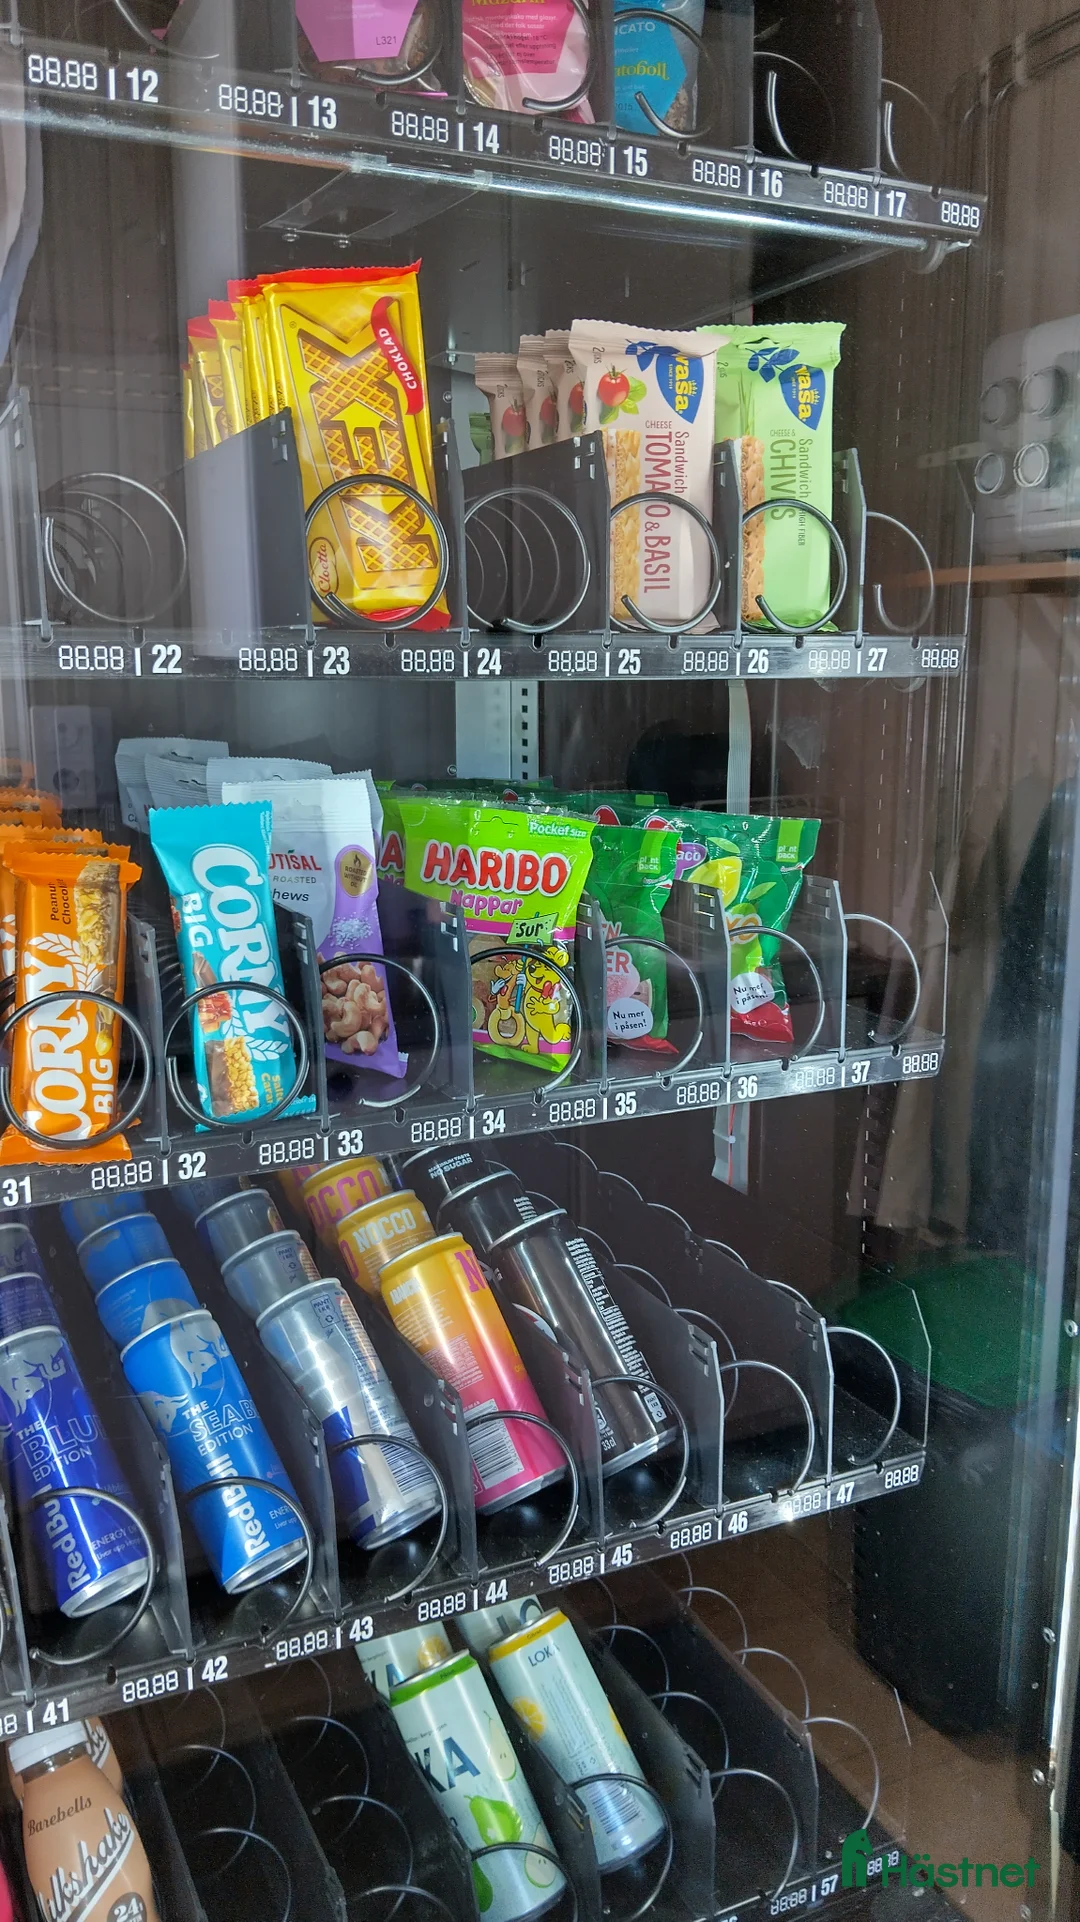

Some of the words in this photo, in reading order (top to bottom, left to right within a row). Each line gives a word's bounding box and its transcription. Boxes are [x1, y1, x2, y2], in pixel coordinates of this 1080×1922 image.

[376, 36, 397, 45] L321
[28, 54, 98, 91] 88.88
[126, 68, 159, 103] 12
[218, 83, 282, 118] 88.88
[308, 96, 338, 129] 13
[392, 110, 449, 143] 88.88
[473, 122, 501, 154] 14
[549, 135, 602, 166] 88.88
[623, 146, 648, 176] 15
[692, 158, 741, 188] 88.88
[760, 169, 783, 198] 16
[824, 181, 868, 209] 88.88
[885, 191, 907, 218] 17
[941, 201, 980, 228] 88.88
[379, 327, 418, 391] CHOKLAD
[645, 420, 672, 429] CHEESE
[769, 429, 790, 437] CHEESE
[645, 431, 673, 518] TOMAO
[675, 431, 689, 494] Sandwich
[799, 438, 814, 500] Sandwich
[645, 521, 660, 533] &
[320, 543, 331, 594] Cloetta
[644, 536, 672, 594] BASIL
[58, 645, 125, 672] 88.88
[151, 644, 183, 674] 22
[239, 647, 298, 673] 88.88
[323, 646, 350, 675] 23
[401, 648, 455, 673] 88.88
[476, 646, 502, 675] 24
[548, 649, 598, 672] 88.88
[618, 648, 641, 675] 25
[683, 650, 729, 672] 88.88
[747, 648, 769, 674] 26
[808, 649, 851, 671] 88.88
[868, 647, 888, 672] 27
[921, 649, 959, 669] 88.88
[529, 822, 569, 835] Pocket
[639, 855, 659, 864] plnt
[778, 844, 797, 852] plnt
[273, 875, 316, 884] ROASTED
[421, 840, 571, 896] HARIBO
[639, 862, 659, 871] pack
[450, 889, 523, 916] Nappar
[181, 892, 214, 948] BIG
[516, 922, 543, 937] Sur
[192, 846, 289, 1038] CORNY
[733, 985, 747, 997] Nu
[613, 1011, 627, 1020] Nu
[628, 1010, 645, 1019] mer
[620, 1018, 647, 1032] påsen!
[852, 1060, 871, 1084] 37
[903, 1052, 938, 1074] 88.88
[90, 1058, 114, 1115] BIG
[676, 1081, 720, 1105] 88.88
[737, 1075, 758, 1099] 36
[550, 1098, 596, 1123] 88.88
[615, 1091, 637, 1116] 35
[411, 1117, 462, 1143] 88.88
[482, 1109, 506, 1135] 34
[259, 1137, 315, 1165] 88.88
[338, 1128, 364, 1155] 33
[91, 1160, 153, 1191] 88.88
[178, 1152, 207, 1180] 32
[430, 1168, 444, 1179] NO
[443, 1157, 473, 1173] SUGAR
[2, 1176, 32, 1207] 31
[352, 1208, 417, 1254] NOCCO
[313, 1298, 330, 1308] PANT
[182, 1400, 209, 1420] THE
[189, 1403, 244, 1442] SEA
[16, 1420, 42, 1440] THE
[21, 1415, 103, 1470] BLU
[197, 1423, 253, 1456] EDITION
[32, 1445, 92, 1482] EDITION
[885, 1464, 919, 1490] 88.88
[836, 1480, 855, 1505] 47
[92, 1528, 127, 1551] ENERGY
[671, 1522, 712, 1549] 88.88
[729, 1510, 749, 1536] 46
[549, 1557, 594, 1584] 88.88
[611, 1543, 633, 1568] 45
[418, 1592, 466, 1622] 88.88
[486, 1578, 508, 1604] 44
[276, 1630, 328, 1661] 88.88
[349, 1616, 374, 1643] 43
[122, 1674, 179, 1703] 88.88
[201, 1655, 228, 1682] 42
[42, 1698, 70, 1726] 41
[27, 1795, 92, 1837] Barebells
[820, 1873, 839, 1896] 57
